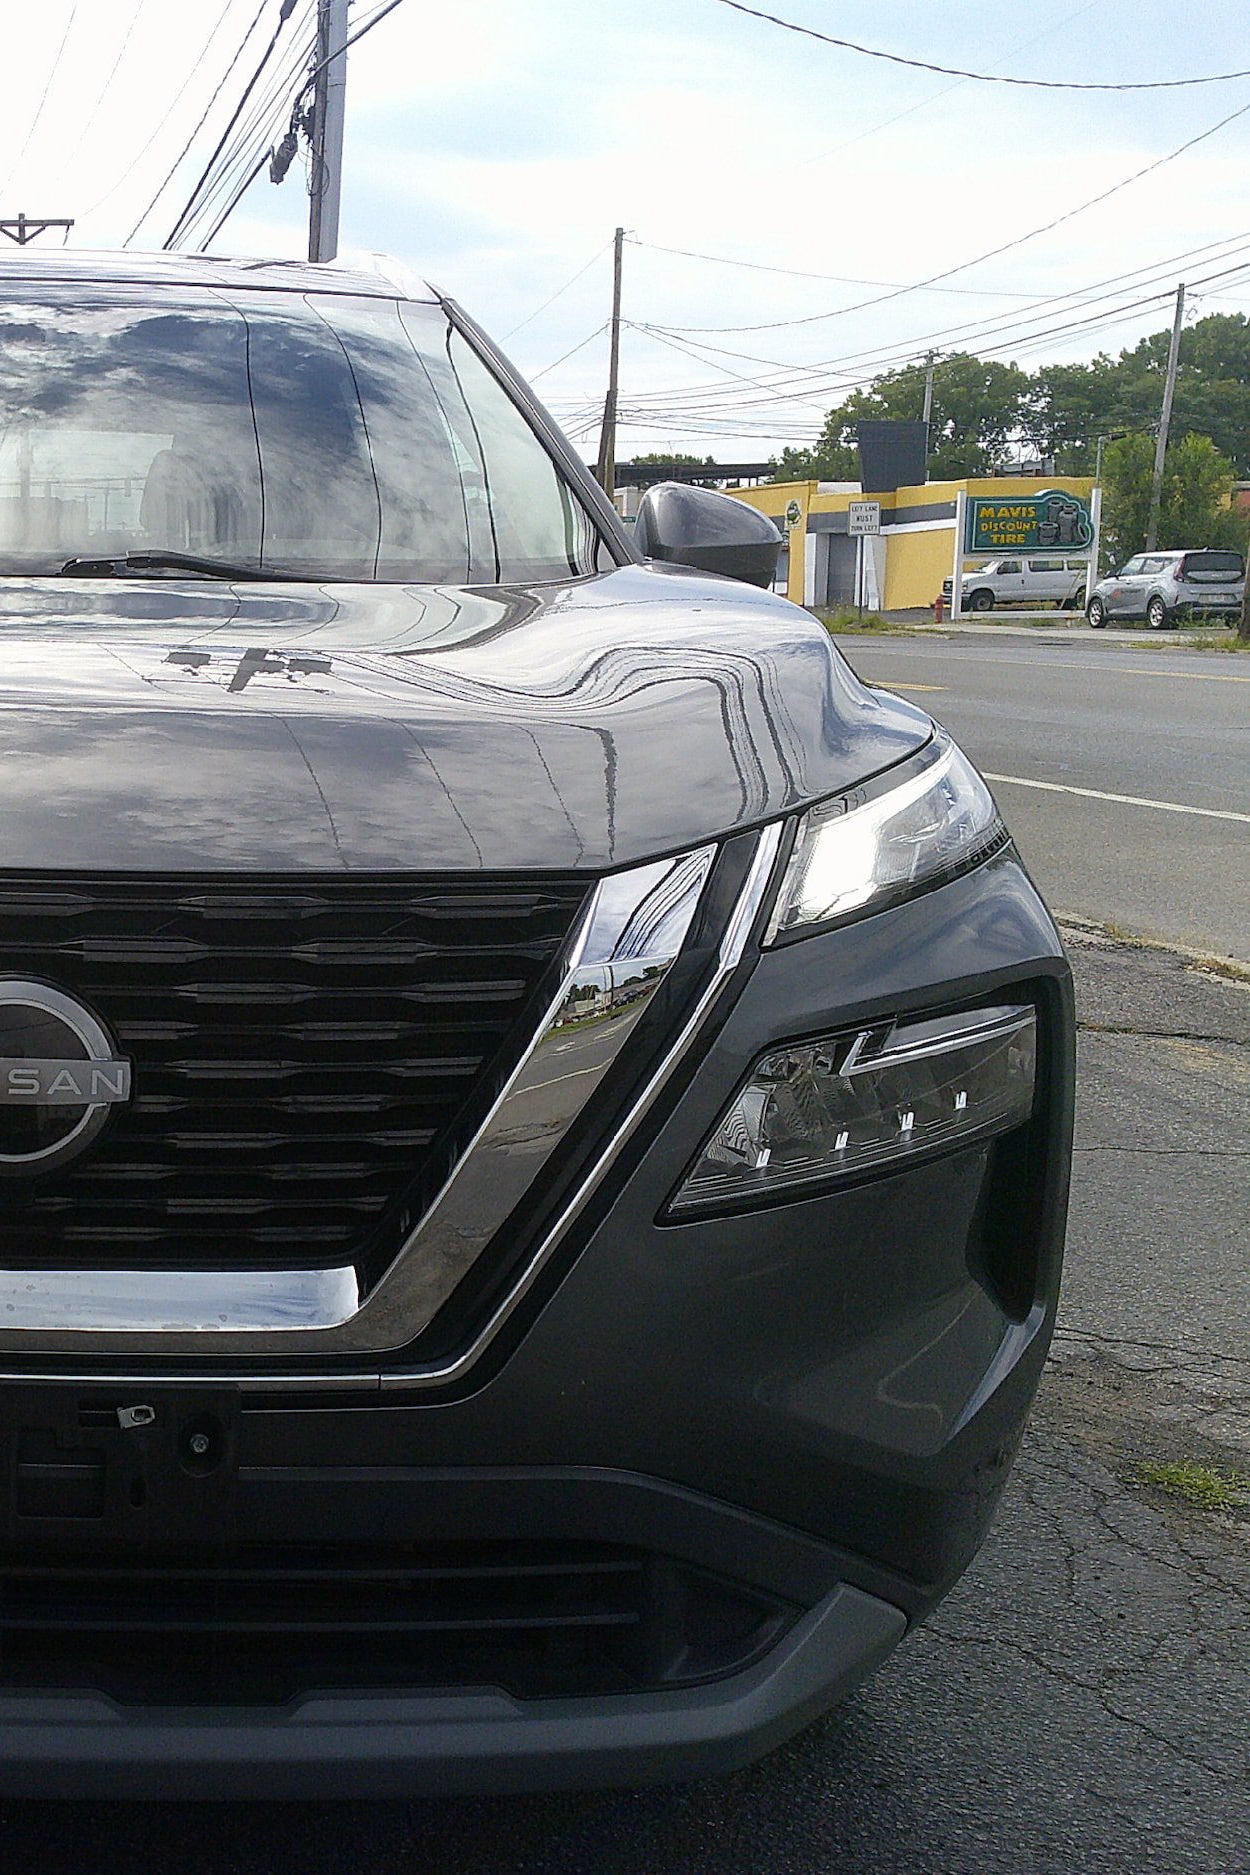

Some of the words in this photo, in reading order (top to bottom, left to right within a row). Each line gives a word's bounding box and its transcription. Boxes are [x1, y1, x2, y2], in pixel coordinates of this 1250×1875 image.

[980, 507, 1036, 518] MAVIS
[980, 521, 1037, 532] DISCOUNT
[990, 534, 1026, 544] TIRE
